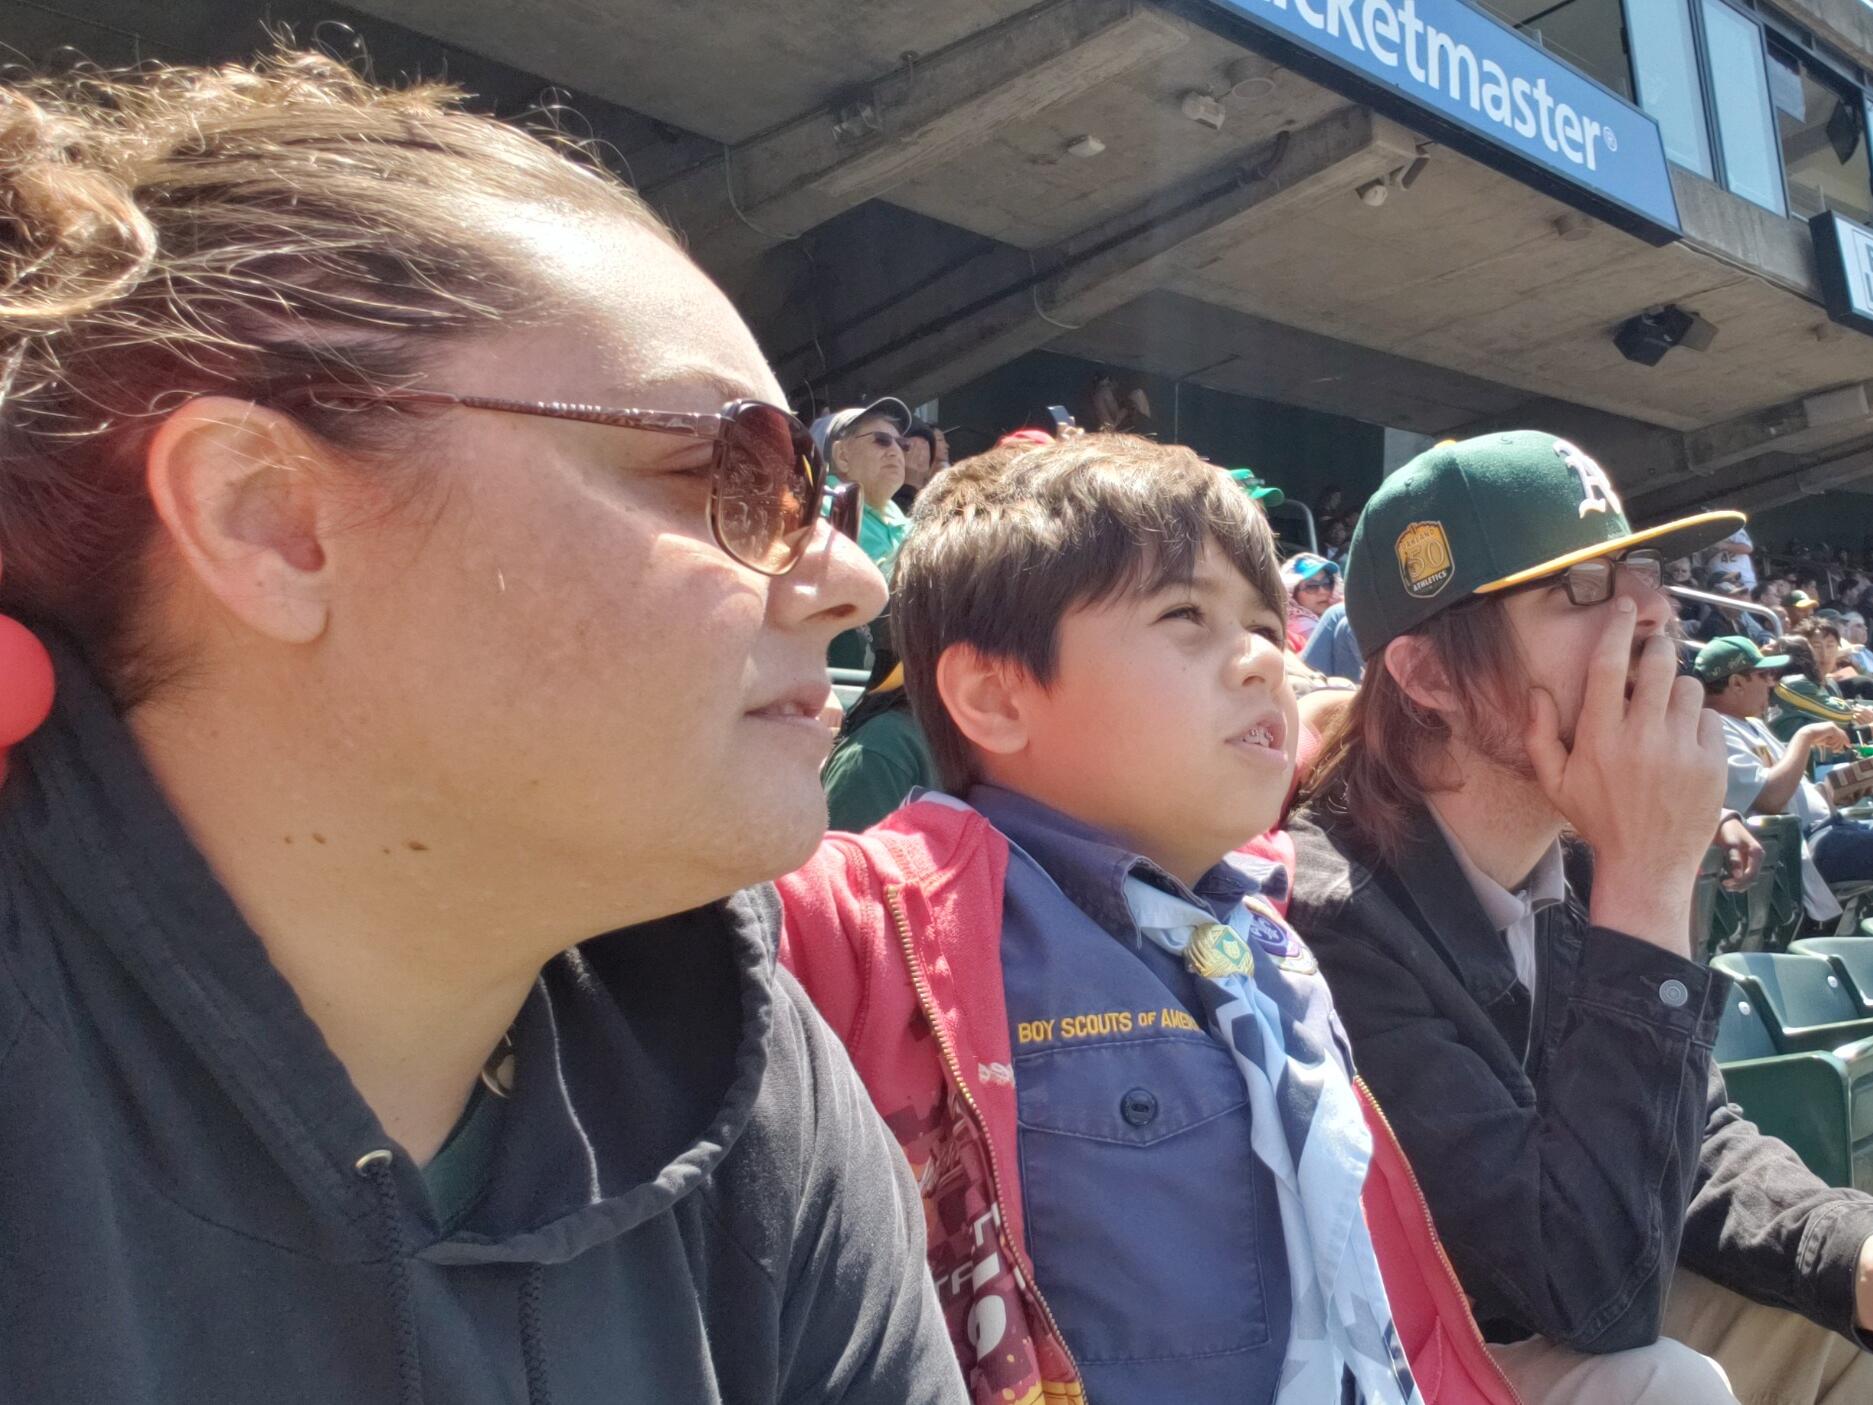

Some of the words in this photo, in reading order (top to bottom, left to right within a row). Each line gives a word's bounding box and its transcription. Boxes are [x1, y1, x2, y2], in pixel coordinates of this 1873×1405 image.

[1412, 568, 1447, 592] ATHLETICS
[1017, 1020, 1056, 1043] BOY
[1060, 1012, 1132, 1038] SCOUTS
[1138, 1012, 1156, 1026] OF
